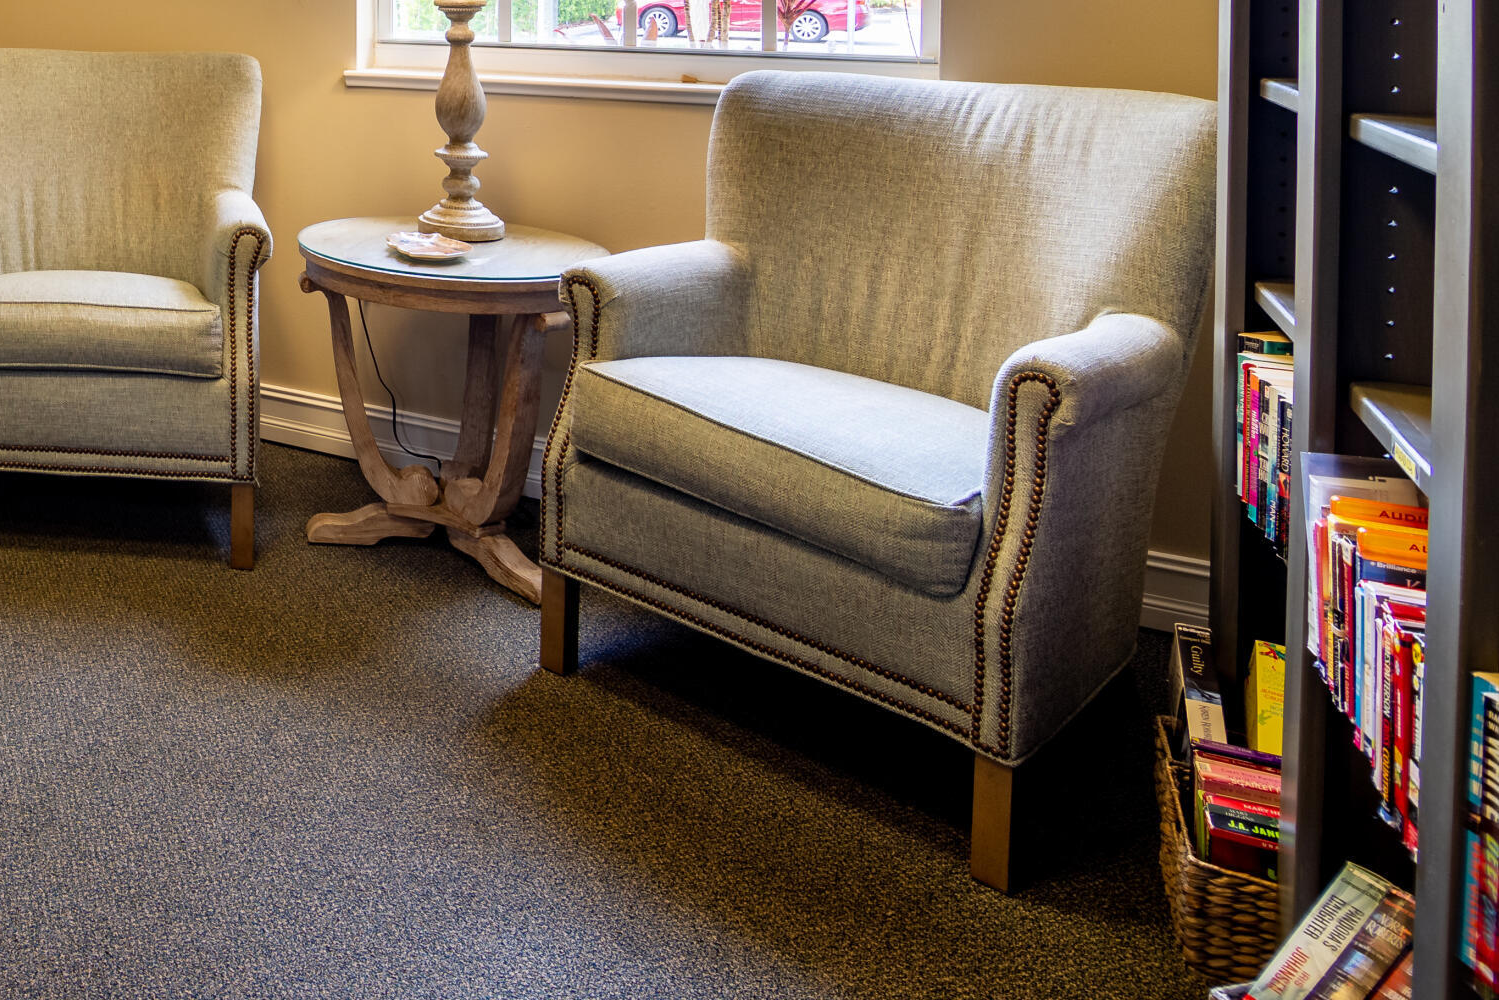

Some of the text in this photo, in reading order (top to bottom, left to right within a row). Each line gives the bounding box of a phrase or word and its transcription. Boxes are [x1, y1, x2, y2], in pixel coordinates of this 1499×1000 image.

[1281, 427, 1289, 472] HOWARD
[1377, 561, 1417, 573] Brilliance
[1190, 644, 1203, 676] Guilty
[1382, 635, 1393, 718] JAMES PATTERSON
[1303, 894, 1346, 940] DAUGHTER
[1324, 905, 1365, 952] PANDORA'S
[1268, 946, 1310, 995] JOHANSEN
[1294, 971, 1310, 988] IRIS
